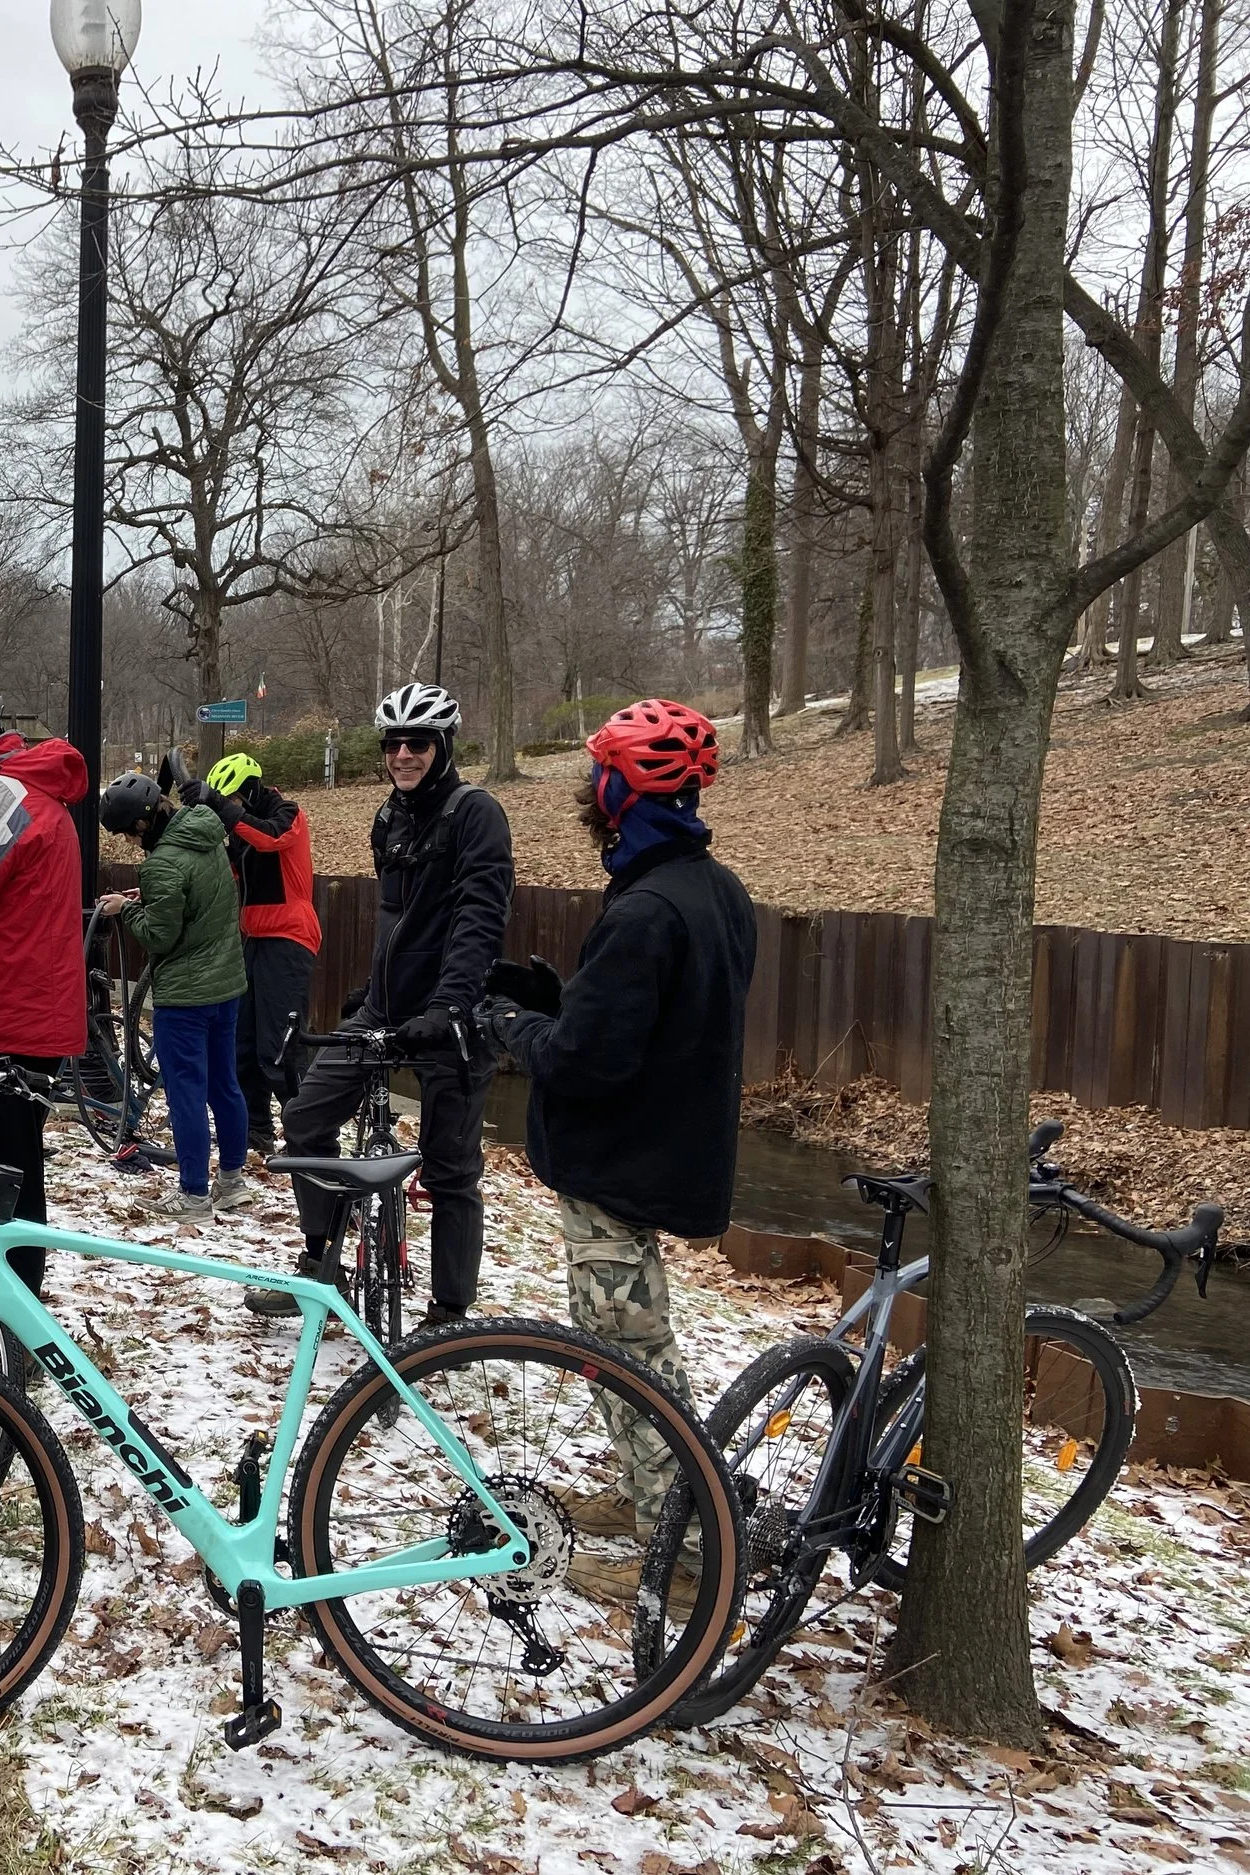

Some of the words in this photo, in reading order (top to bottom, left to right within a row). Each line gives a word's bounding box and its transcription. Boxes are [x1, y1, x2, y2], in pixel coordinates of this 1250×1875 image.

[245, 1274, 291, 1286] ARCADEX
[32, 1341, 191, 1513] Bianchi
[410, 1715, 461, 1743] PIRELLI
